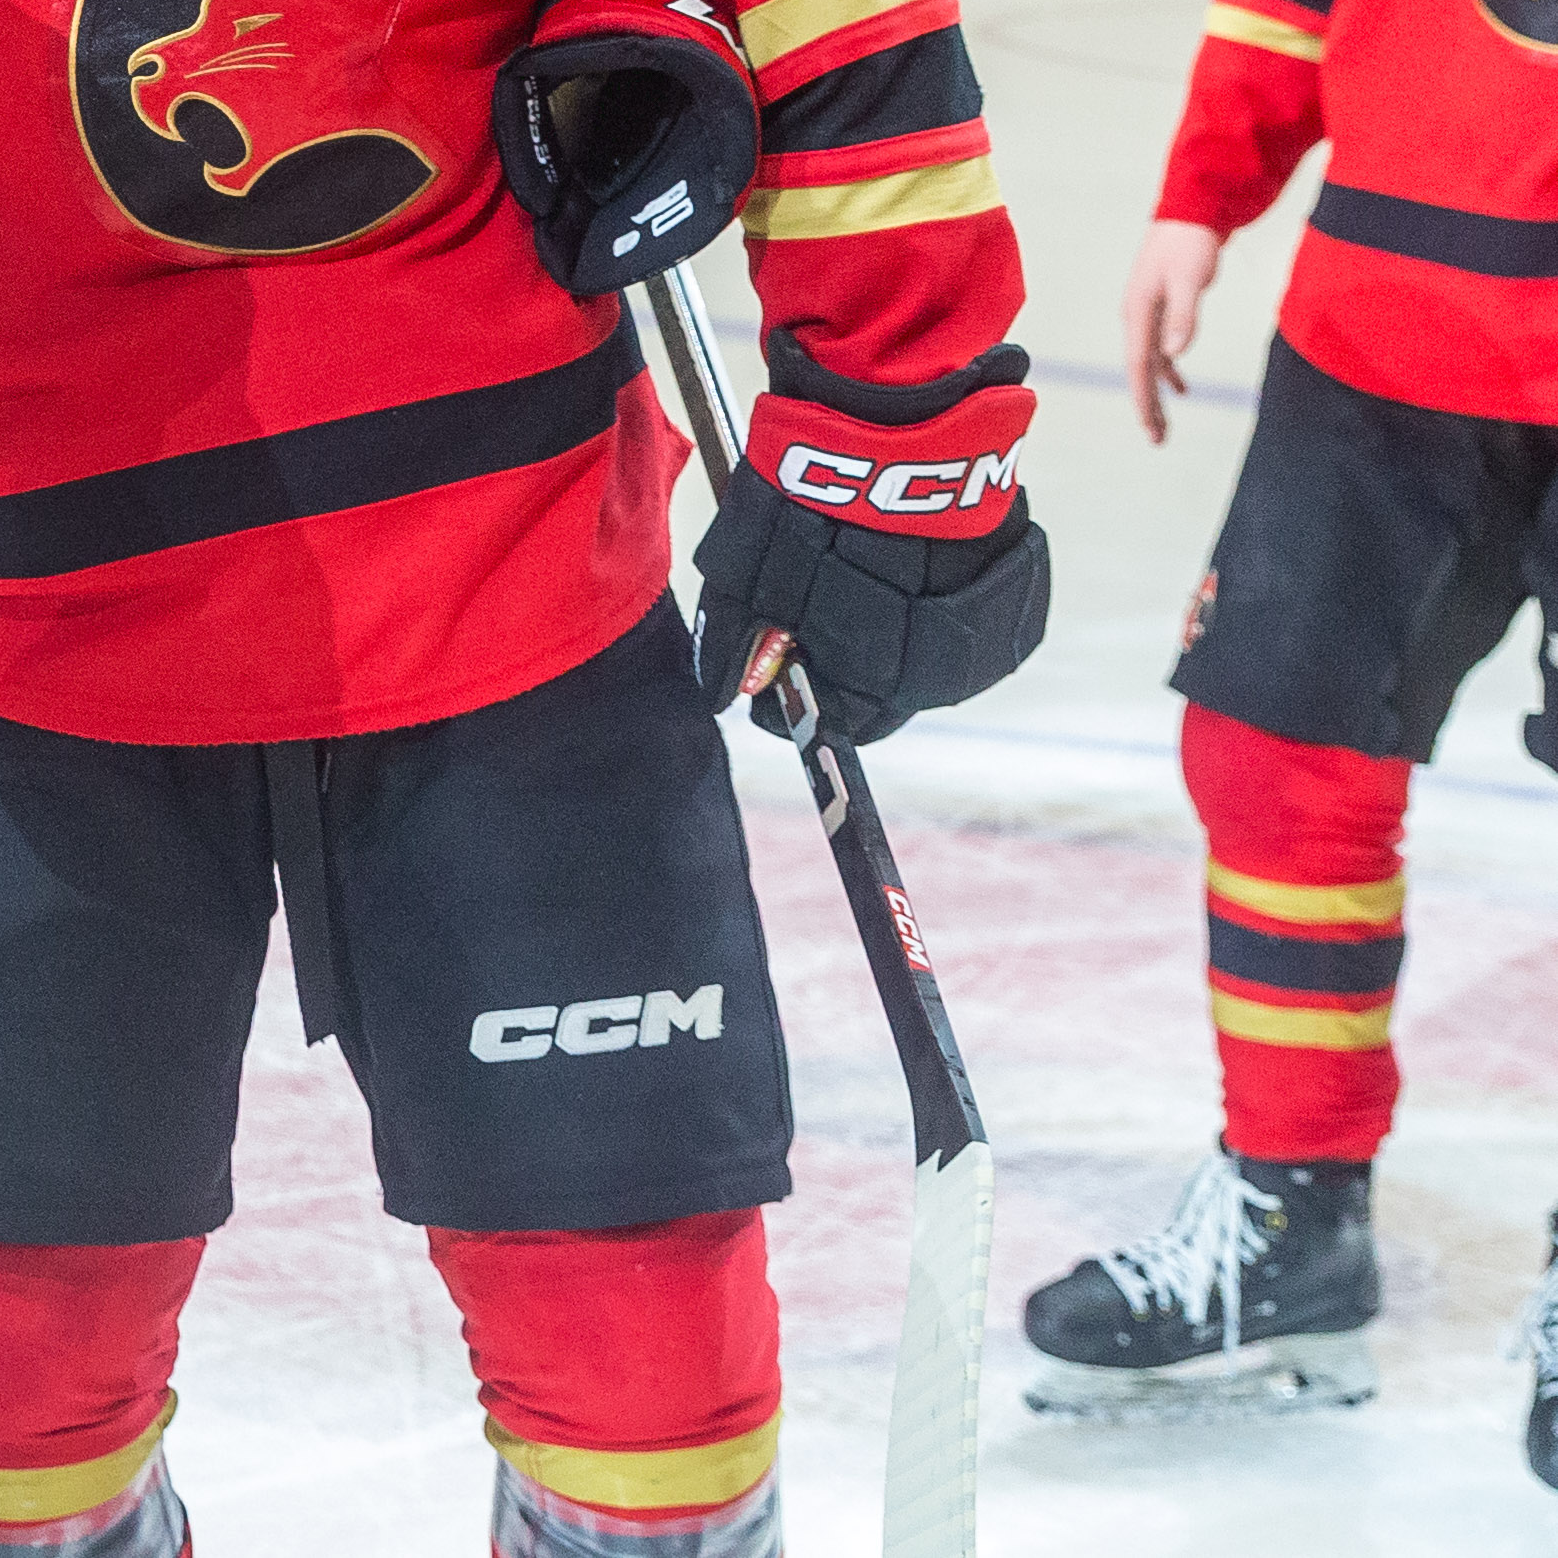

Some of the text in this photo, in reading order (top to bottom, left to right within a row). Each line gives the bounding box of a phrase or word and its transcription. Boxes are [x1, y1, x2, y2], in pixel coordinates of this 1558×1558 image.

[777, 438, 1022, 513] CCM
[885, 889, 931, 969] CCM
[469, 983, 724, 1064] CCM
